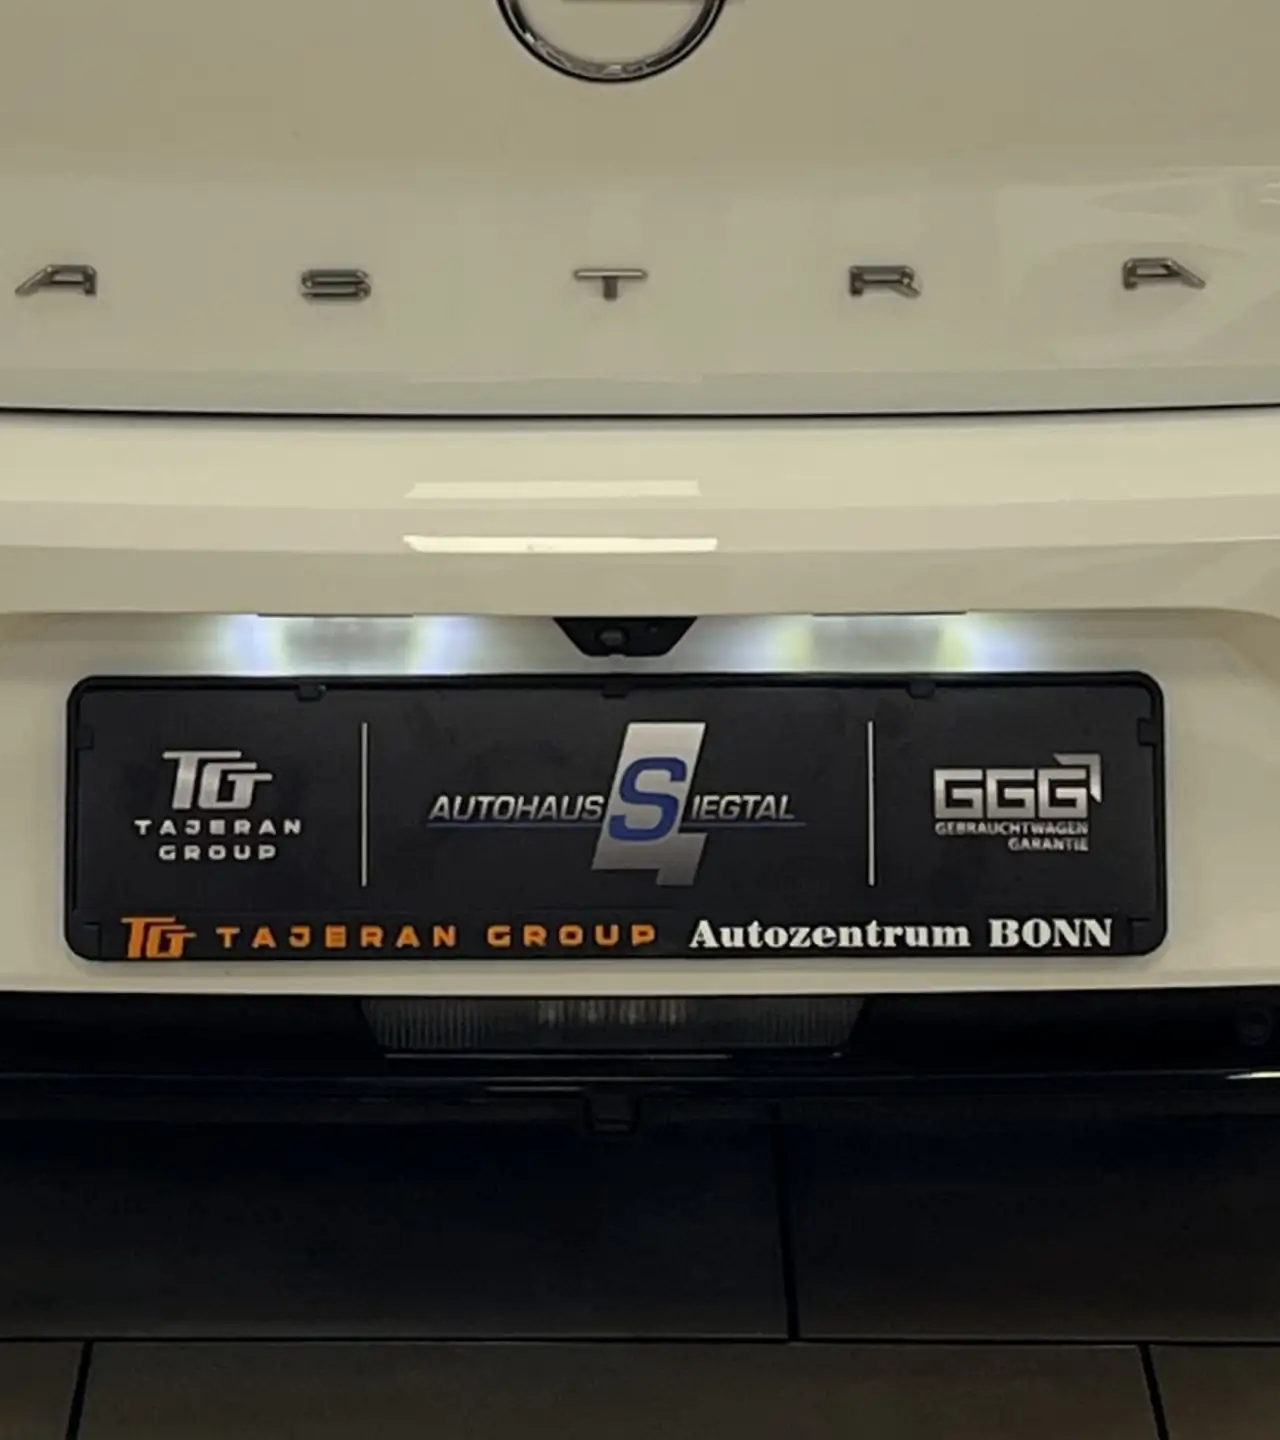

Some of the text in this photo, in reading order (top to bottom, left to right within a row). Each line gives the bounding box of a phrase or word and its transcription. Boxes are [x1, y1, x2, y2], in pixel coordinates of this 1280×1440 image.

[15, 257, 1207, 302] ASTRA
[933, 768, 1088, 820] GGG
[428, 794, 606, 821] AUTOHAUS
[134, 819, 302, 835] TAJERAN
[934, 821, 1089, 835] GEBRAUCHTWAGEN
[159, 845, 276, 860] GROUP
[1007, 837, 1089, 852] GARANTIE
[216, 924, 456, 948] TAJERAN
[487, 924, 656, 948] GROUP
[689, 919, 971, 948] Autozentrum
[988, 918, 1113, 948] BONN
